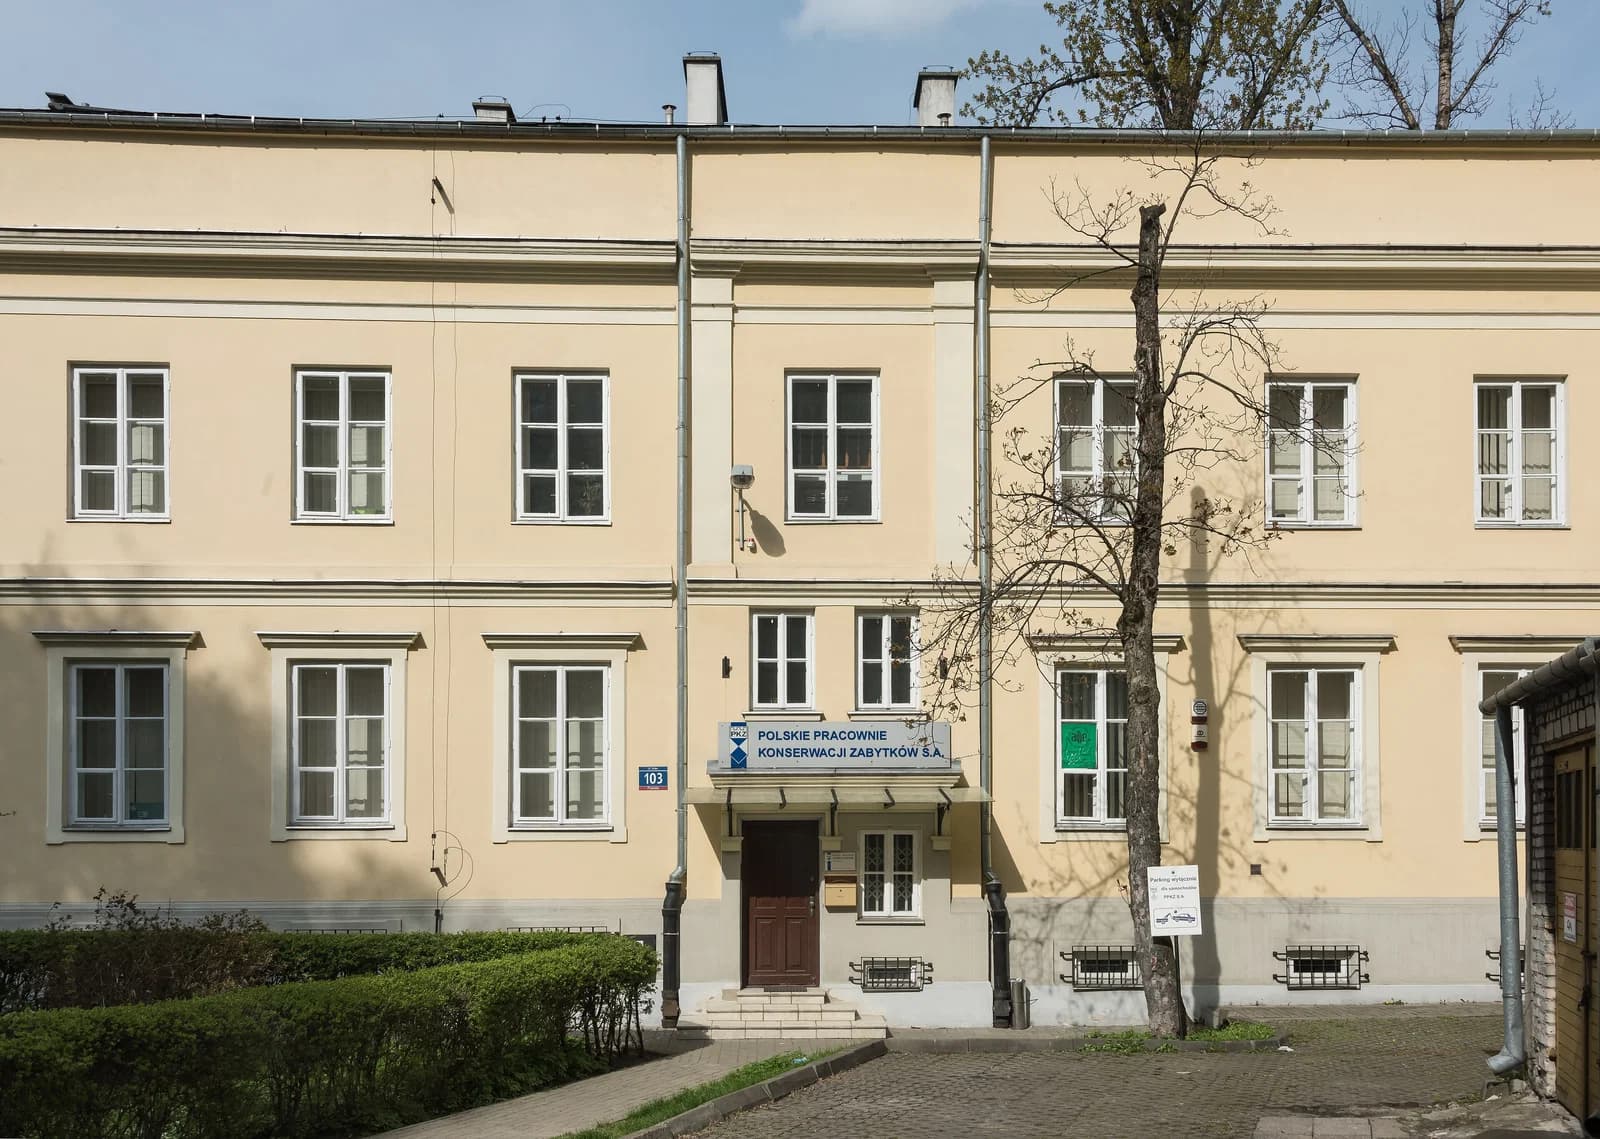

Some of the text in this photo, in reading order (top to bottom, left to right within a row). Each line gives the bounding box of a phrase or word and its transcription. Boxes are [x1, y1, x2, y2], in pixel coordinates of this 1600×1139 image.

[758, 730, 887, 741] POLSKIE PRACOWNIE
[758, 747, 847, 758] KONSERWACJI
[849, 744, 918, 758] ZABYTKÓW
[644, 772, 663, 784] 103
